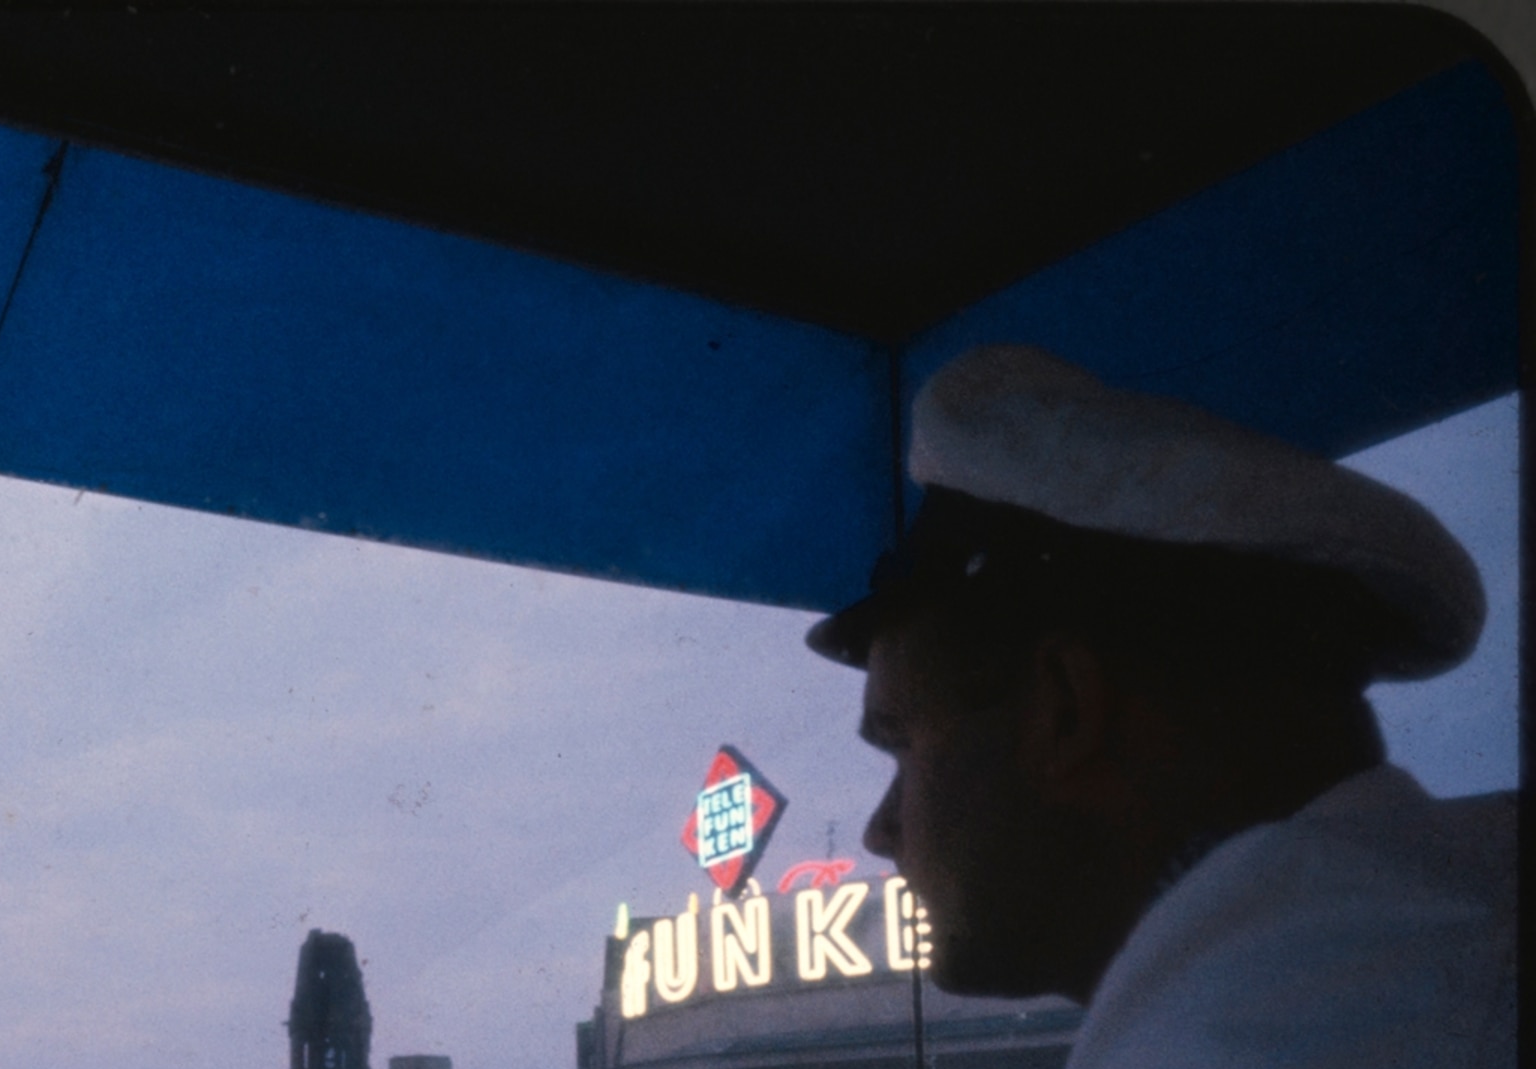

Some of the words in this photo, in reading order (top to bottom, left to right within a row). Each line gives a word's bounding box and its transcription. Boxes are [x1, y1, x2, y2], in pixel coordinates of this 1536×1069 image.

[703, 784, 745, 814] TELE
[704, 806, 745, 836] FUN
[703, 827, 746, 856] KEN
